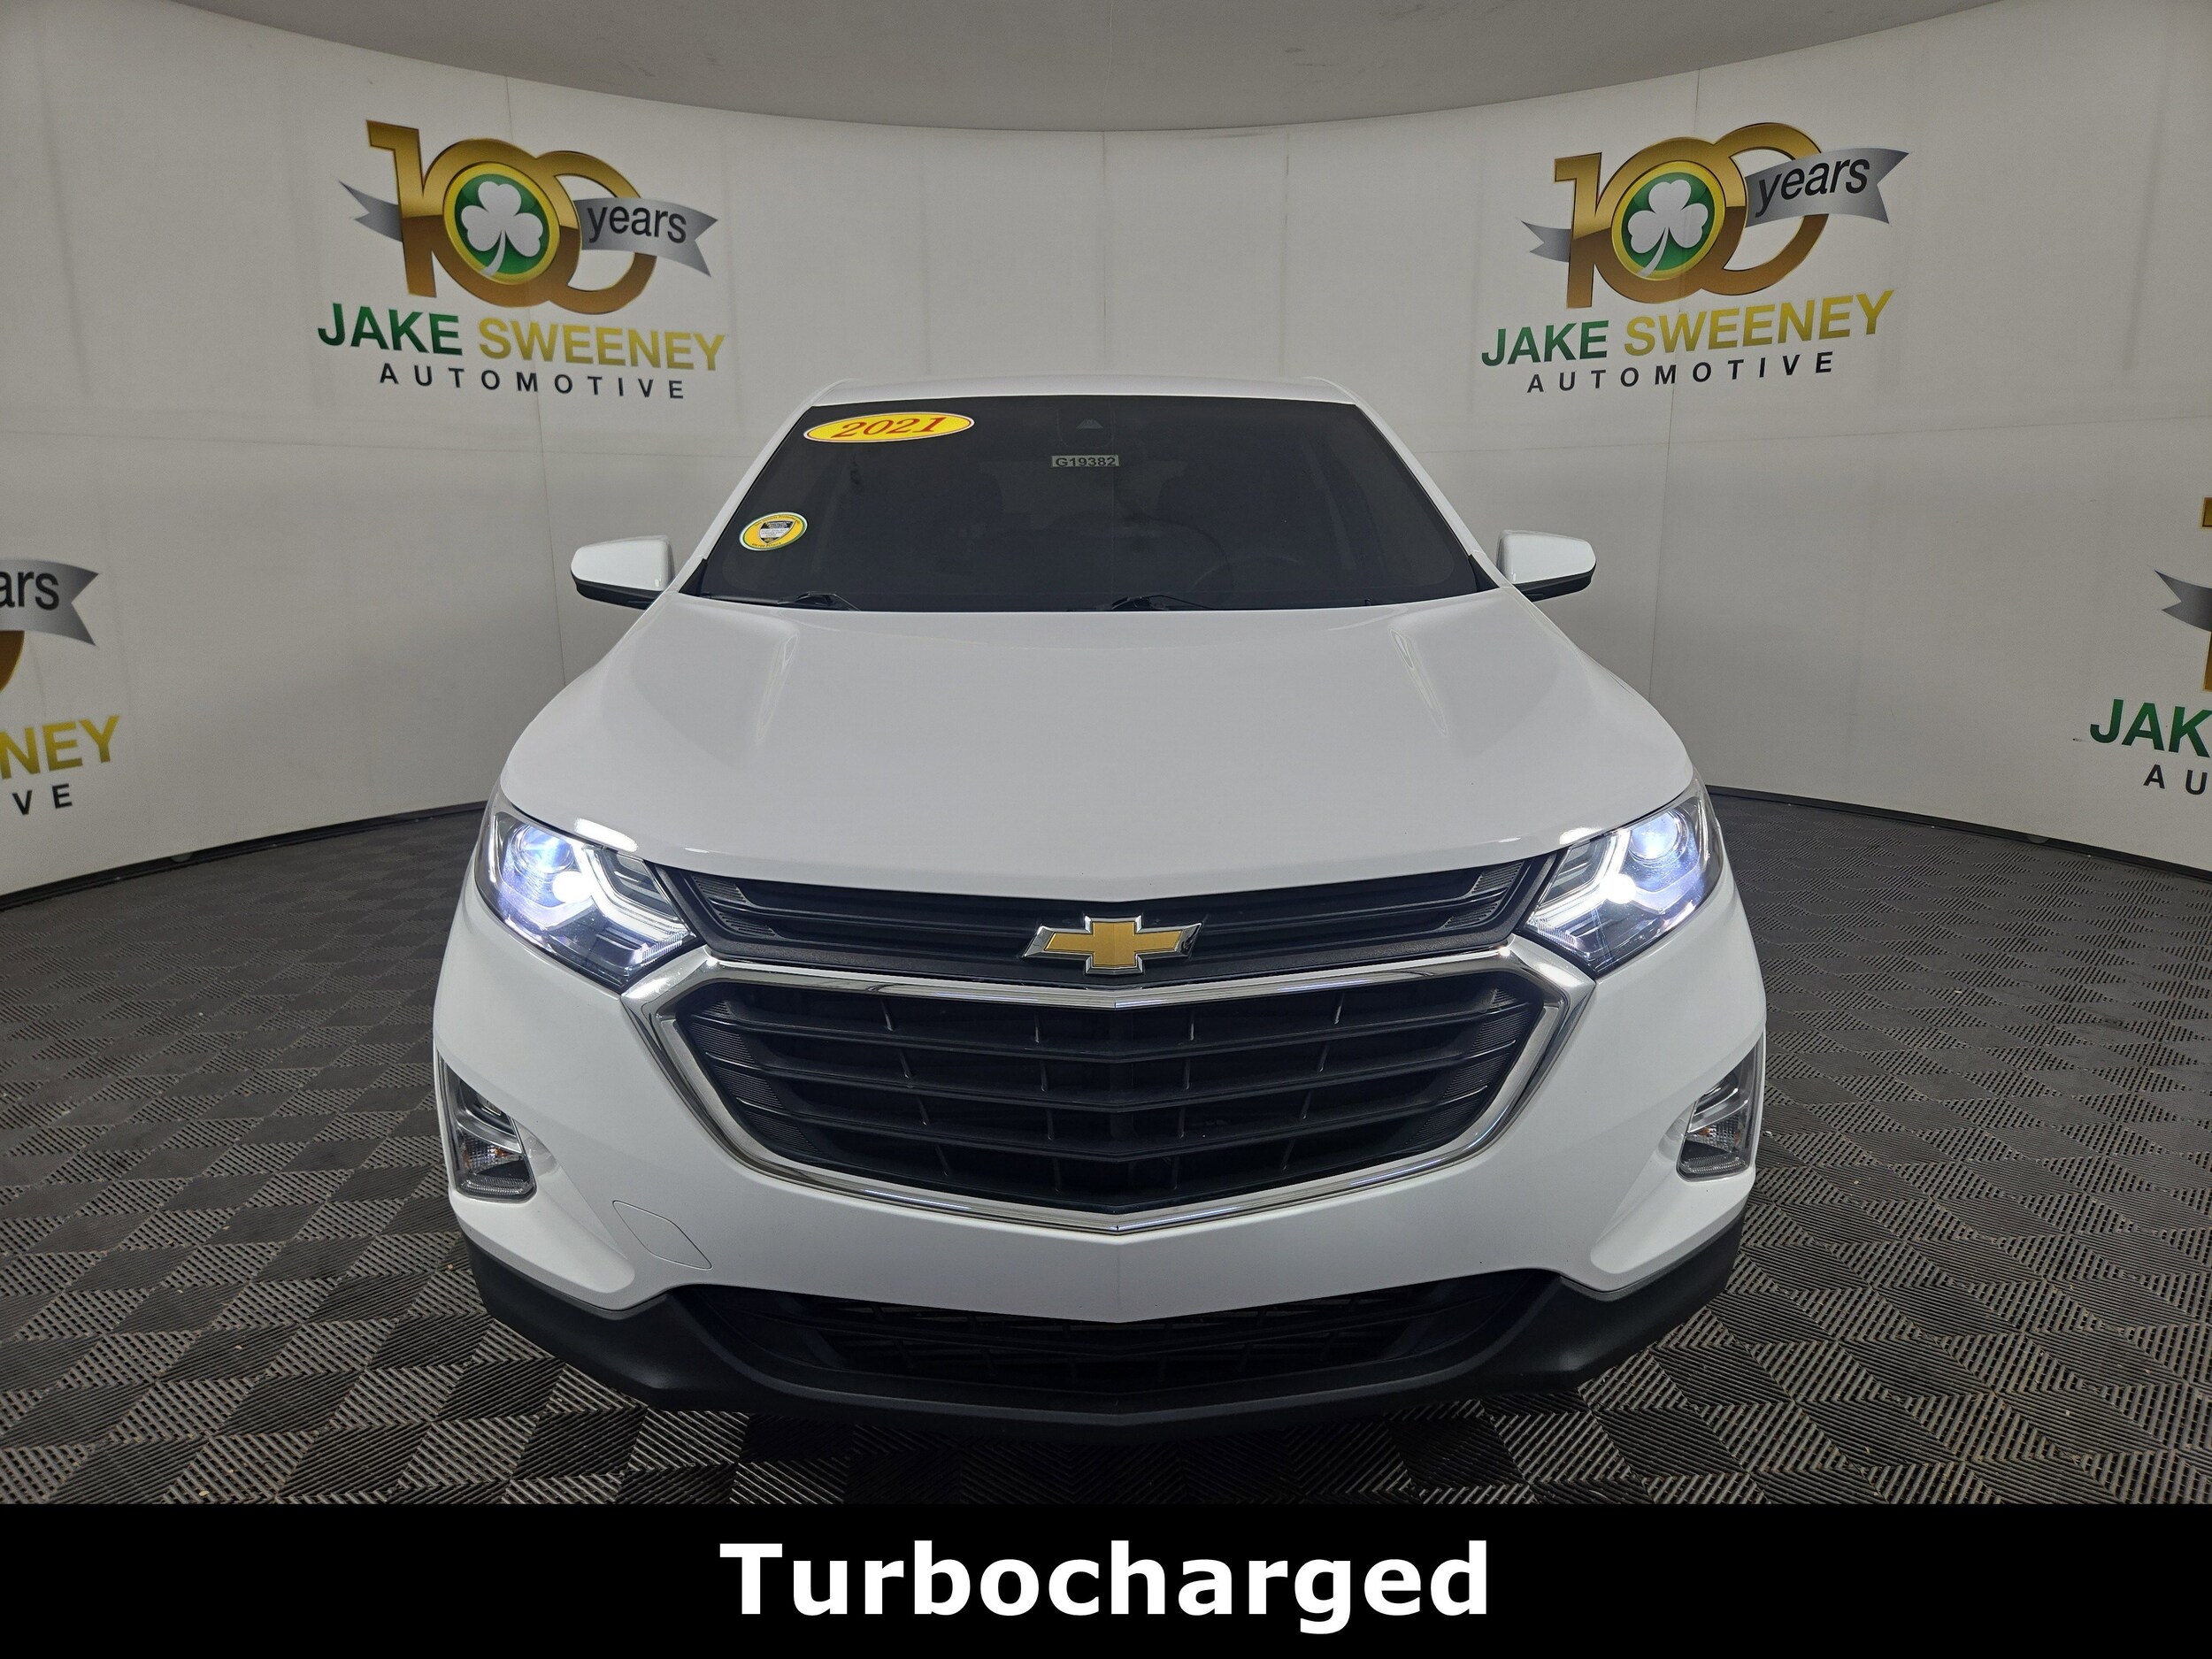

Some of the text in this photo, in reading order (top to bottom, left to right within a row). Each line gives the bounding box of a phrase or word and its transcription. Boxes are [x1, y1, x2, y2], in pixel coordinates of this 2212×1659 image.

[1755, 157, 1870, 219] years
[588, 204, 687, 244] years
[318, 303, 726, 372] JAKE SWEENEY
[1481, 289, 1895, 366] JAKE SWEENEY
[379, 363, 685, 400] AUTOMOTIVE
[1526, 351, 1834, 394] AUTOMOTIVE
[830, 417, 947, 439] 2021
[1056, 457, 1116, 467] G19382
